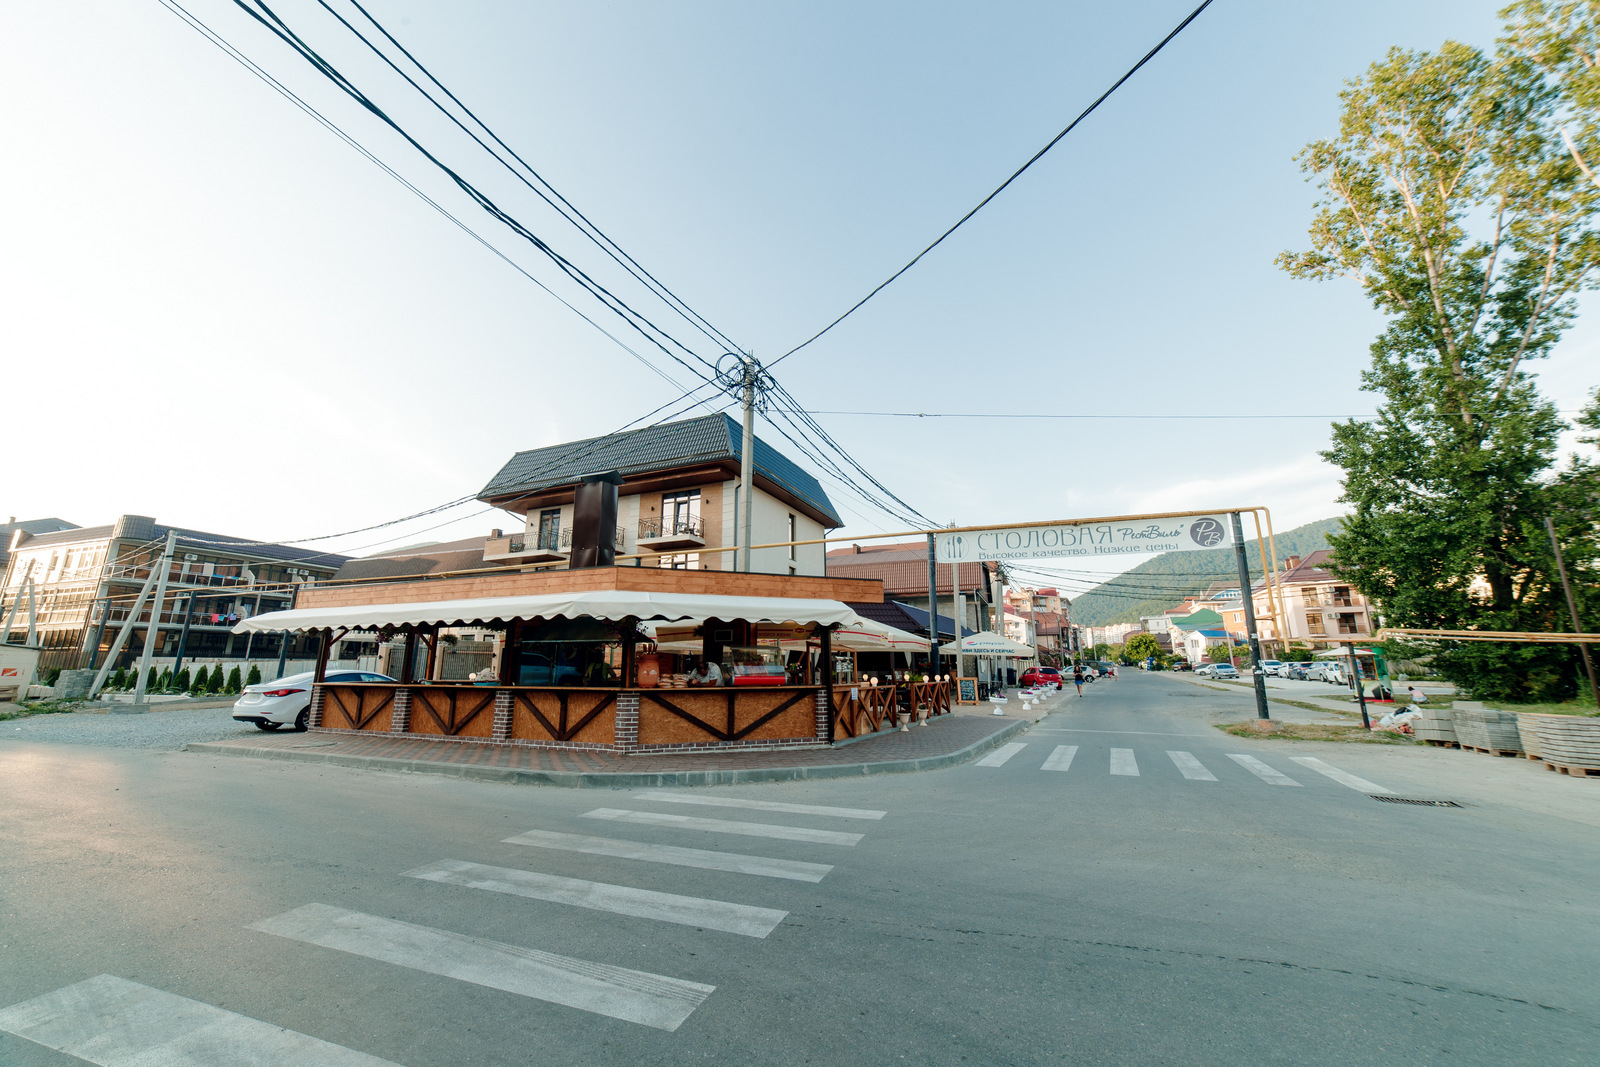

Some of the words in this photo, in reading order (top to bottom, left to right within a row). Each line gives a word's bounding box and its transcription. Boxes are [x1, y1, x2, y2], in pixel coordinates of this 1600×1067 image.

[977, 527, 1112, 550] СТОЛОВАЯ
[978, 551, 1028, 560] Высокое
[1095, 545, 1141, 554] Низкие
[1146, 543, 1179, 552] цены
